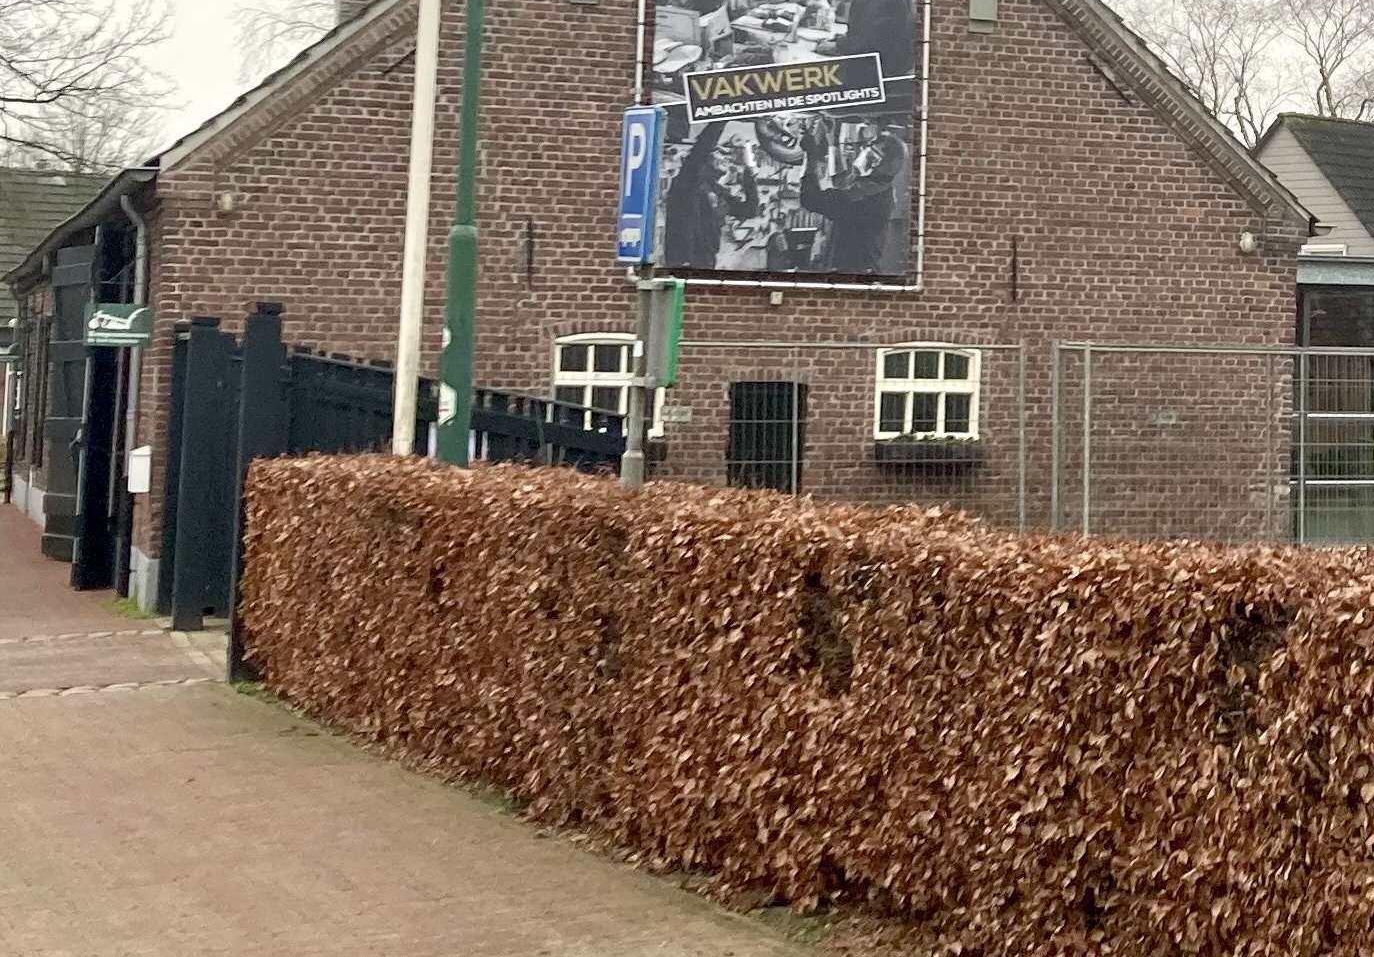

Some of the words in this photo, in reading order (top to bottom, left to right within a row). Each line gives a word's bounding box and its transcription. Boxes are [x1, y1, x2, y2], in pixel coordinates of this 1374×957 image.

[691, 63, 843, 101] VAKWERK
[694, 99, 772, 118] AMBACHTEN
[773, 98, 787, 109] IN
[788, 96, 804, 106] DE
[805, 87, 880, 105] SPOTLIGHTS
[625, 122, 647, 197] P
